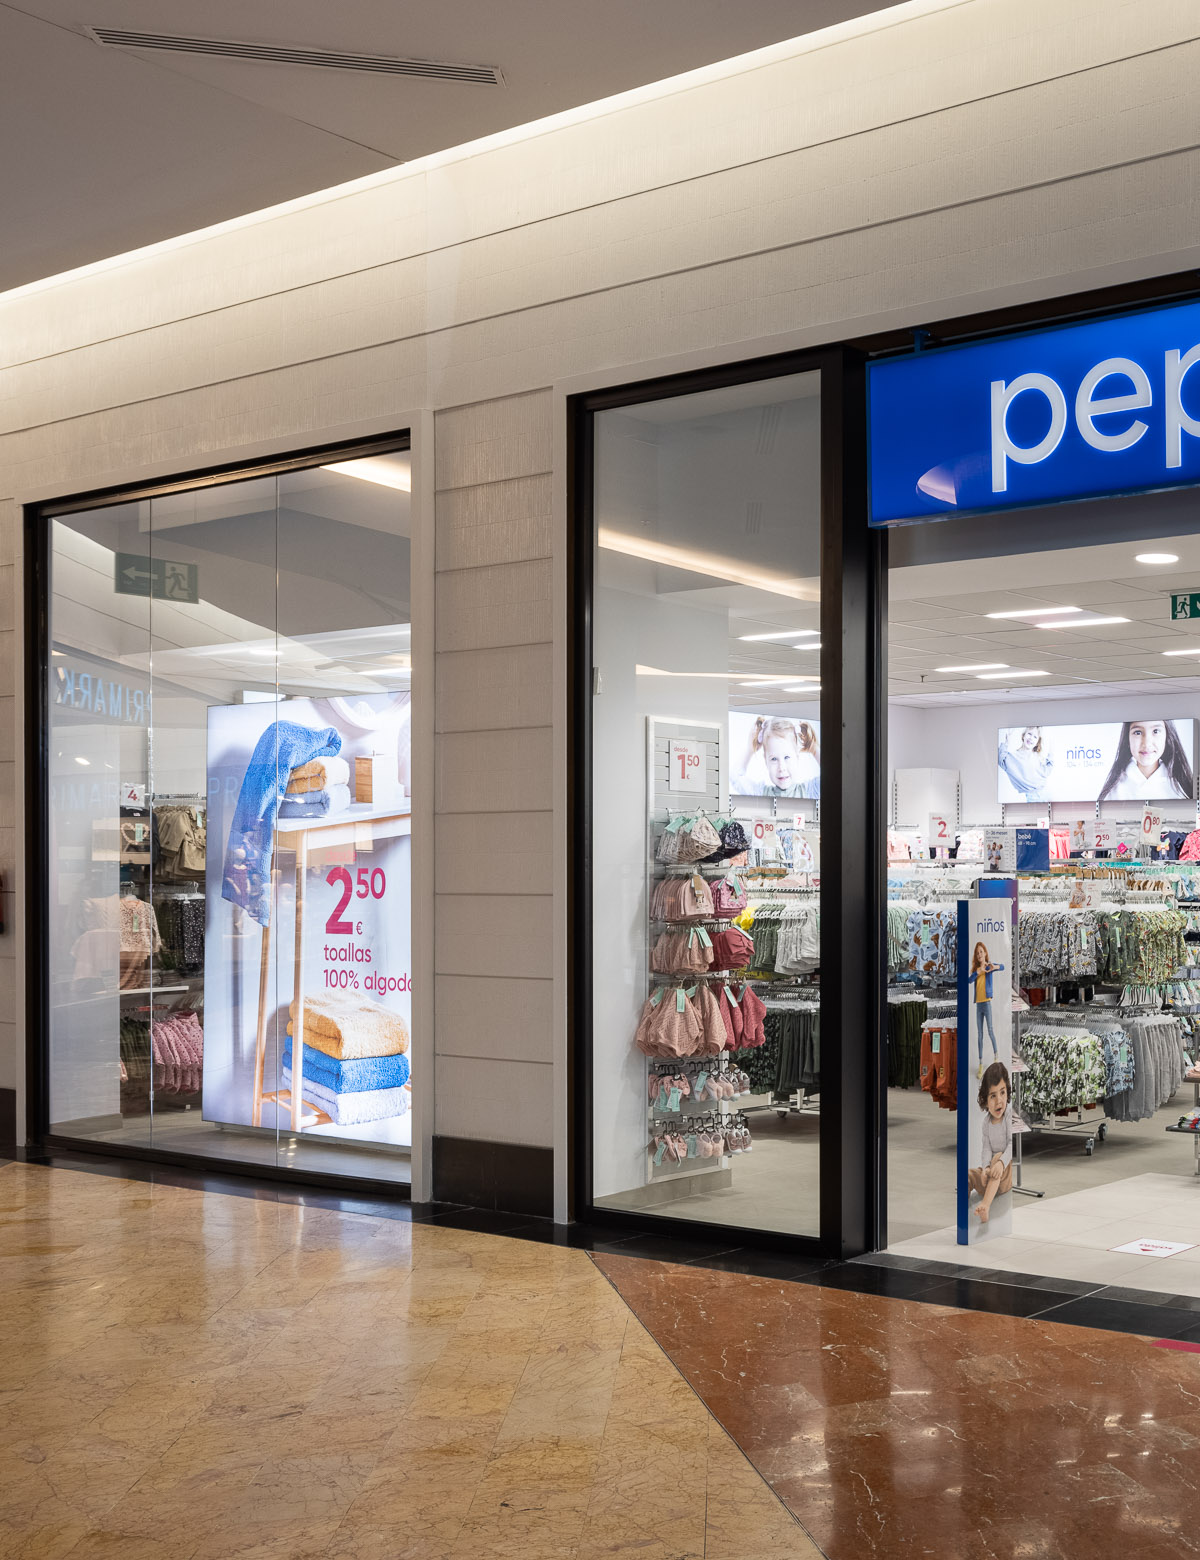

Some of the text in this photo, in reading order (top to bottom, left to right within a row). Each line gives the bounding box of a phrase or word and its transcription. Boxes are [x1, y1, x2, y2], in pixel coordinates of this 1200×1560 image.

[1067, 746, 1102, 759] niñas
[937, 820, 947, 838] 2
[976, 918, 1005, 933] niños
[323, 942, 372, 963] toallas
[323, 969, 359, 990] 100%
